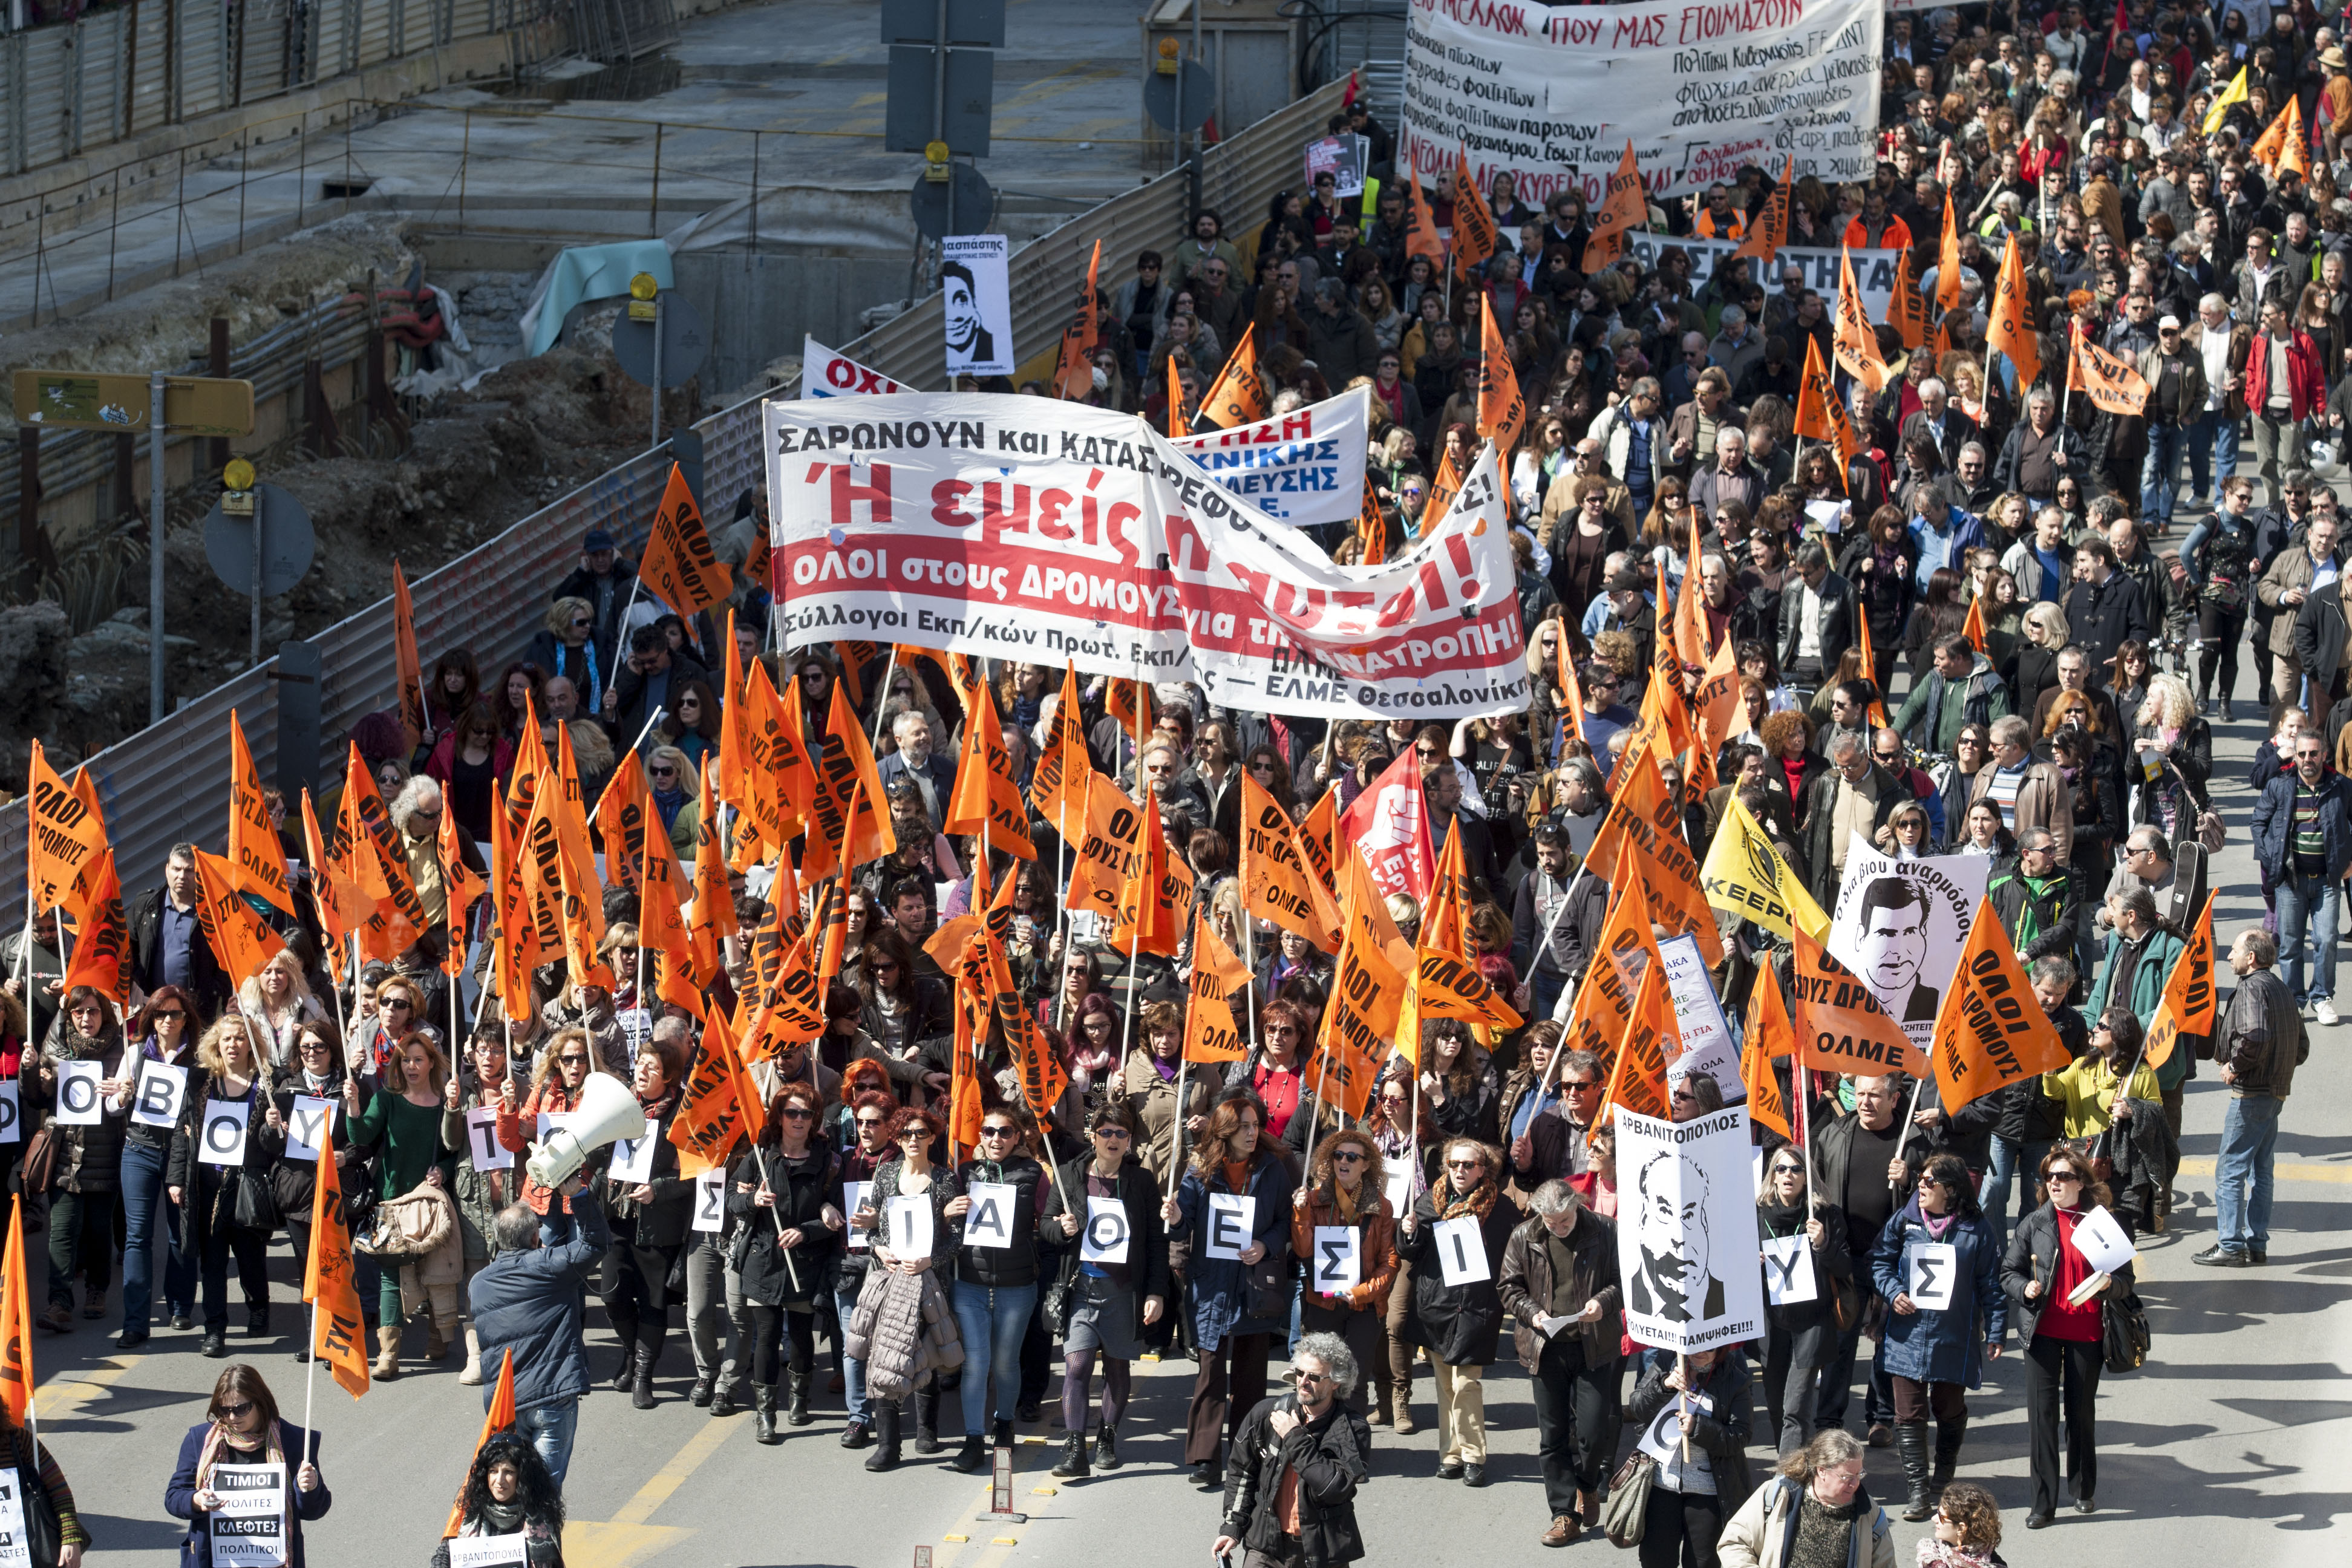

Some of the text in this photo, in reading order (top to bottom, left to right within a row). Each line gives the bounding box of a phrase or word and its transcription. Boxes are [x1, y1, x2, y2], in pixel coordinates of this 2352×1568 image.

[1552, 17, 1602, 45] ΠΟΥ
[1612, 15, 1668, 49] ΜΑΣ
[778, 421, 1048, 456] ΣΑΡΩΝΟΥΝ και
[675, 501, 716, 568] ΟΛΟΙ
[931, 467, 1141, 568] εμείς
[793, 547, 887, 586] ΟΛΟΙ
[901, 557, 1008, 601] στους
[1018, 568, 1183, 619] ΔΡΟΜΟΥΣ
[1183, 604, 1235, 639] για
[785, 604, 908, 635] Σύλλογοι
[917, 610, 1037, 645] Εκπ/κών
[1047, 628, 1120, 661] Πρωτ.
[1266, 675, 1348, 703] ΕΛΜΕ
[35, 781, 89, 829] ΟΛΟΙ
[243, 847, 288, 895] ΟΛΜΕ
[1971, 949, 2031, 1034] ΟΛΟΙ
[1579, 1018, 1618, 1073] ΛΜΕ
[1817, 1031, 1905, 1068] ΟΛΜΕ
[1945, 1029, 1968, 1083] ΟΛΜΕ
[1961, 989, 2024, 1080] ΔΡΟΜΟΥΣ
[1622, 1112, 1740, 1144] ΑΡΒΑΝΙΤΟΠΟΥΛΟΣ
[702, 1181, 724, 1220] Σ
[969, 1198, 1006, 1238] Α
[1088, 1212, 1126, 1252] Θ
[1213, 1208, 1241, 1249] Ε
[1321, 1241, 1349, 1281] Σ
[1767, 1250, 1801, 1292] Υ
[1916, 1258, 1944, 1298] Σ
[224, 1474, 272, 1487] ΤΙΜΙΟΙ
[218, 1520, 278, 1534] ΚΛΕΦΤΕΣ
[220, 1544, 278, 1555] ΠΟΛΙΤΙΚΟΙ
[453, 1547, 523, 1563] ΑΡΒΑΝΙΤΟΠΟΥΛΕ
